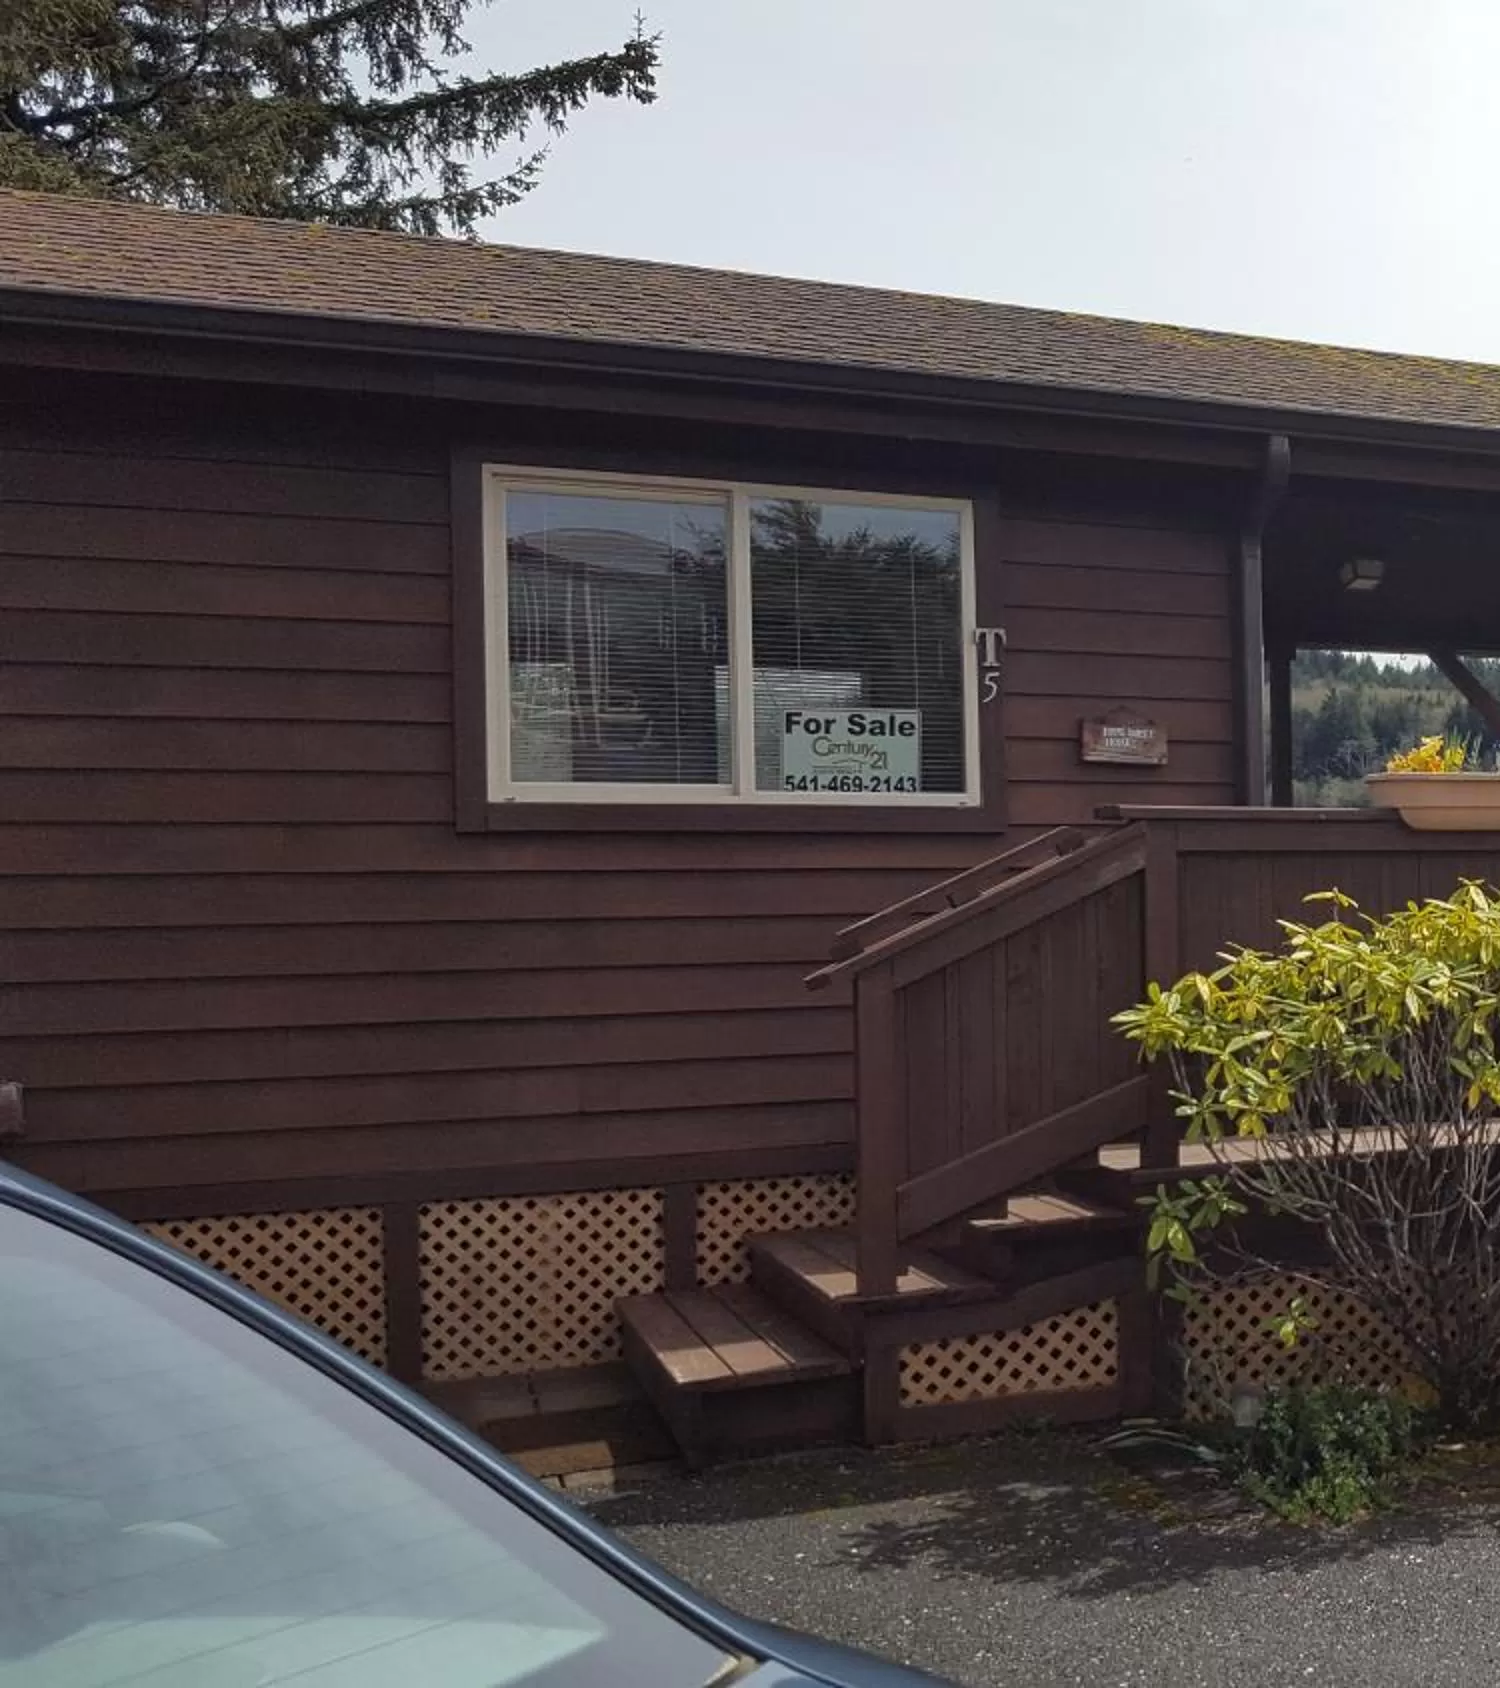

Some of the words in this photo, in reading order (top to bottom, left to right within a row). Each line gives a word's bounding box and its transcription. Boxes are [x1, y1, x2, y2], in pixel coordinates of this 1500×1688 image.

[975, 627, 1007, 667] T
[983, 671, 1000, 703] 5
[785, 711, 836, 735] For
[847, 713, 916, 737] Sale
[812, 736, 875, 757] Century
[869, 751, 888, 770] 21
[784, 774, 917, 792] 541-469-2143
